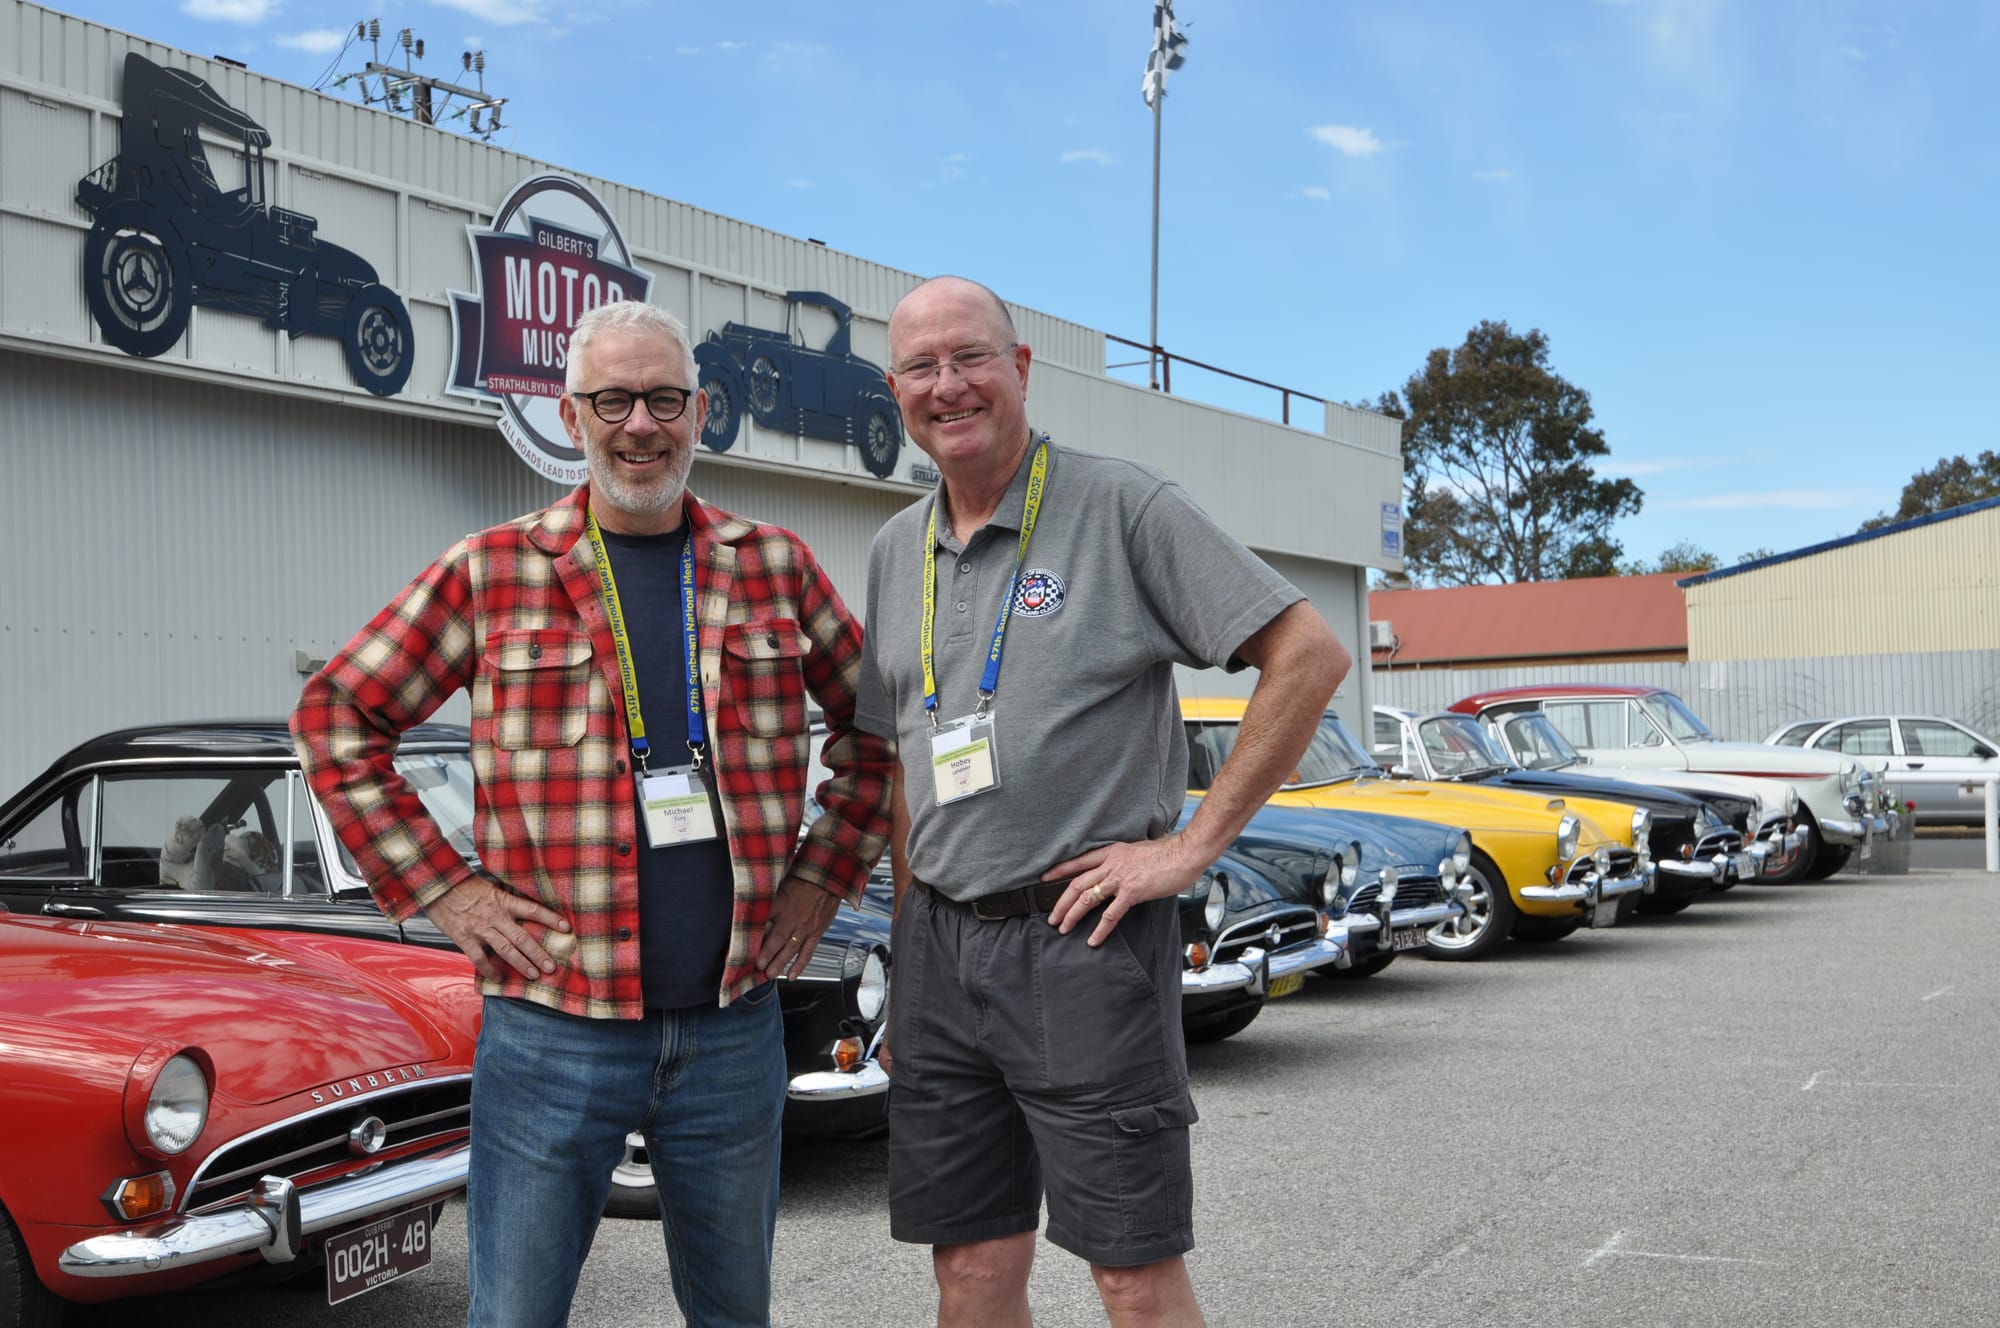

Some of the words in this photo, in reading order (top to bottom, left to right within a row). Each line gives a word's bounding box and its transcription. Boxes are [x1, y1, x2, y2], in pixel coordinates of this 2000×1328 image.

[538, 230, 594, 259] GILBERT'S
[522, 328, 571, 370] MUS
[488, 377, 548, 394] STRATHALBYN
[501, 419, 514, 441] ALL
[515, 438, 541, 468] ROADS
[542, 462, 564, 478] LEAD
[566, 469, 576, 480] TO
[683, 558, 693, 585] Meet
[684, 587, 695, 631] National
[688, 634, 698, 686] Sunbeam
[990, 635, 1003, 661] 47th
[689, 688, 700, 714] 47th
[950, 758, 972, 769] Hobey
[663, 806, 694, 817] Michael
[311, 1064, 425, 1104] SUNBEAM
[365, 1266, 399, 1287] VICTORIA
